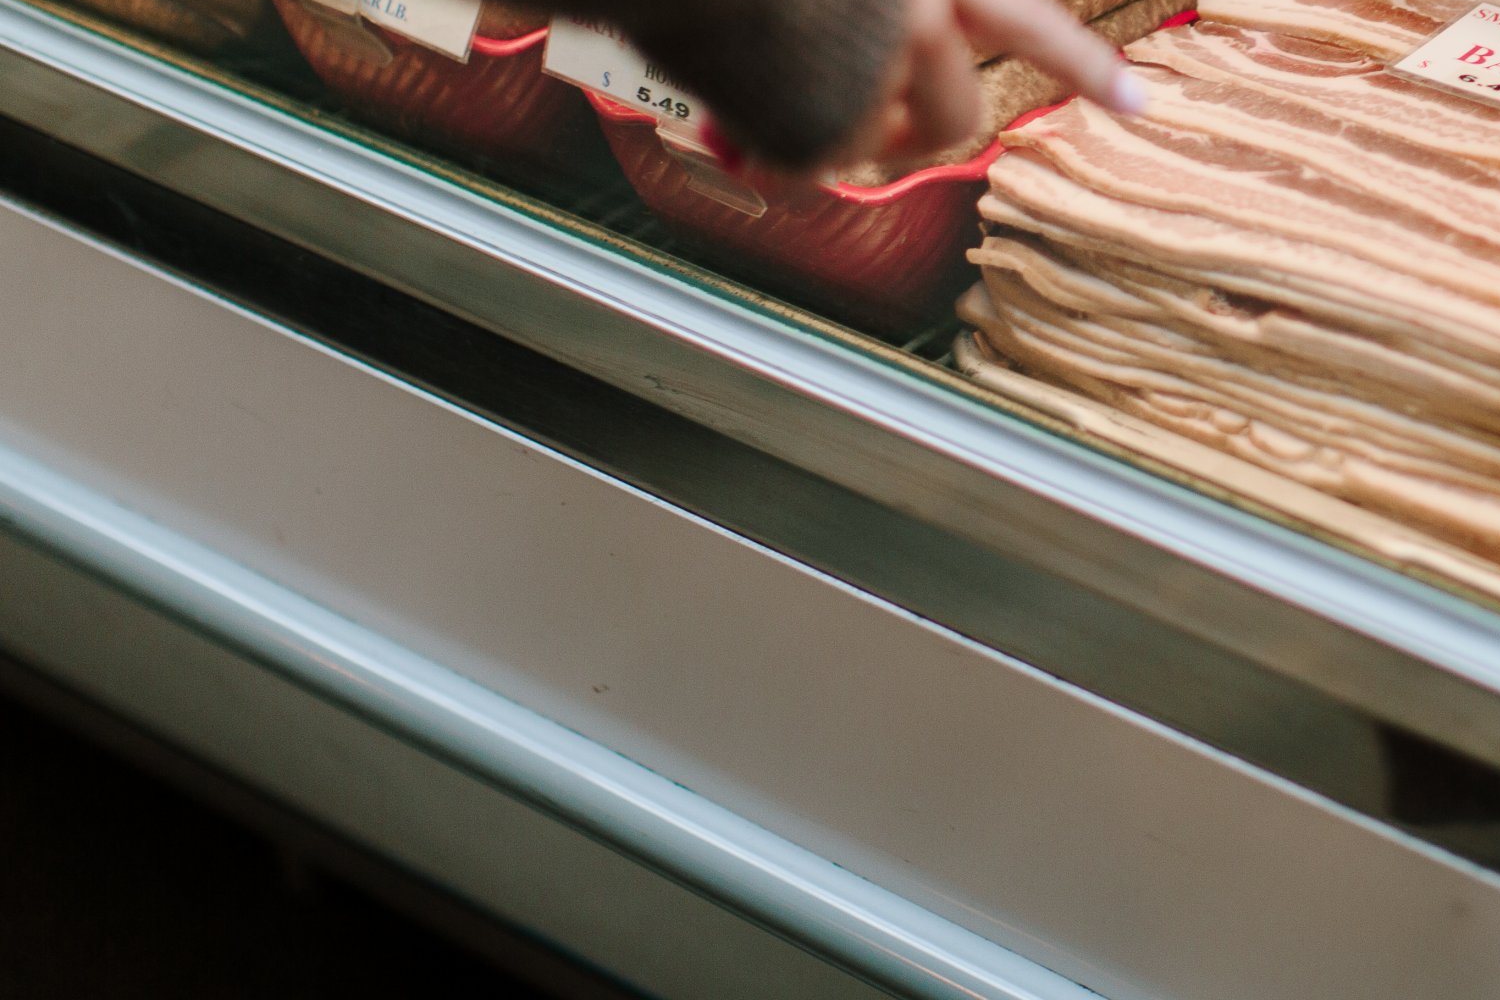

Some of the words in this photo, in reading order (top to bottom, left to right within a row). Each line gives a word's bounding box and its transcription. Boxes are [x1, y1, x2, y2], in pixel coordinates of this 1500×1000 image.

[1416, 59, 1432, 71] $
[602, 70, 612, 89] $
[636, 85, 691, 120] 5.49
